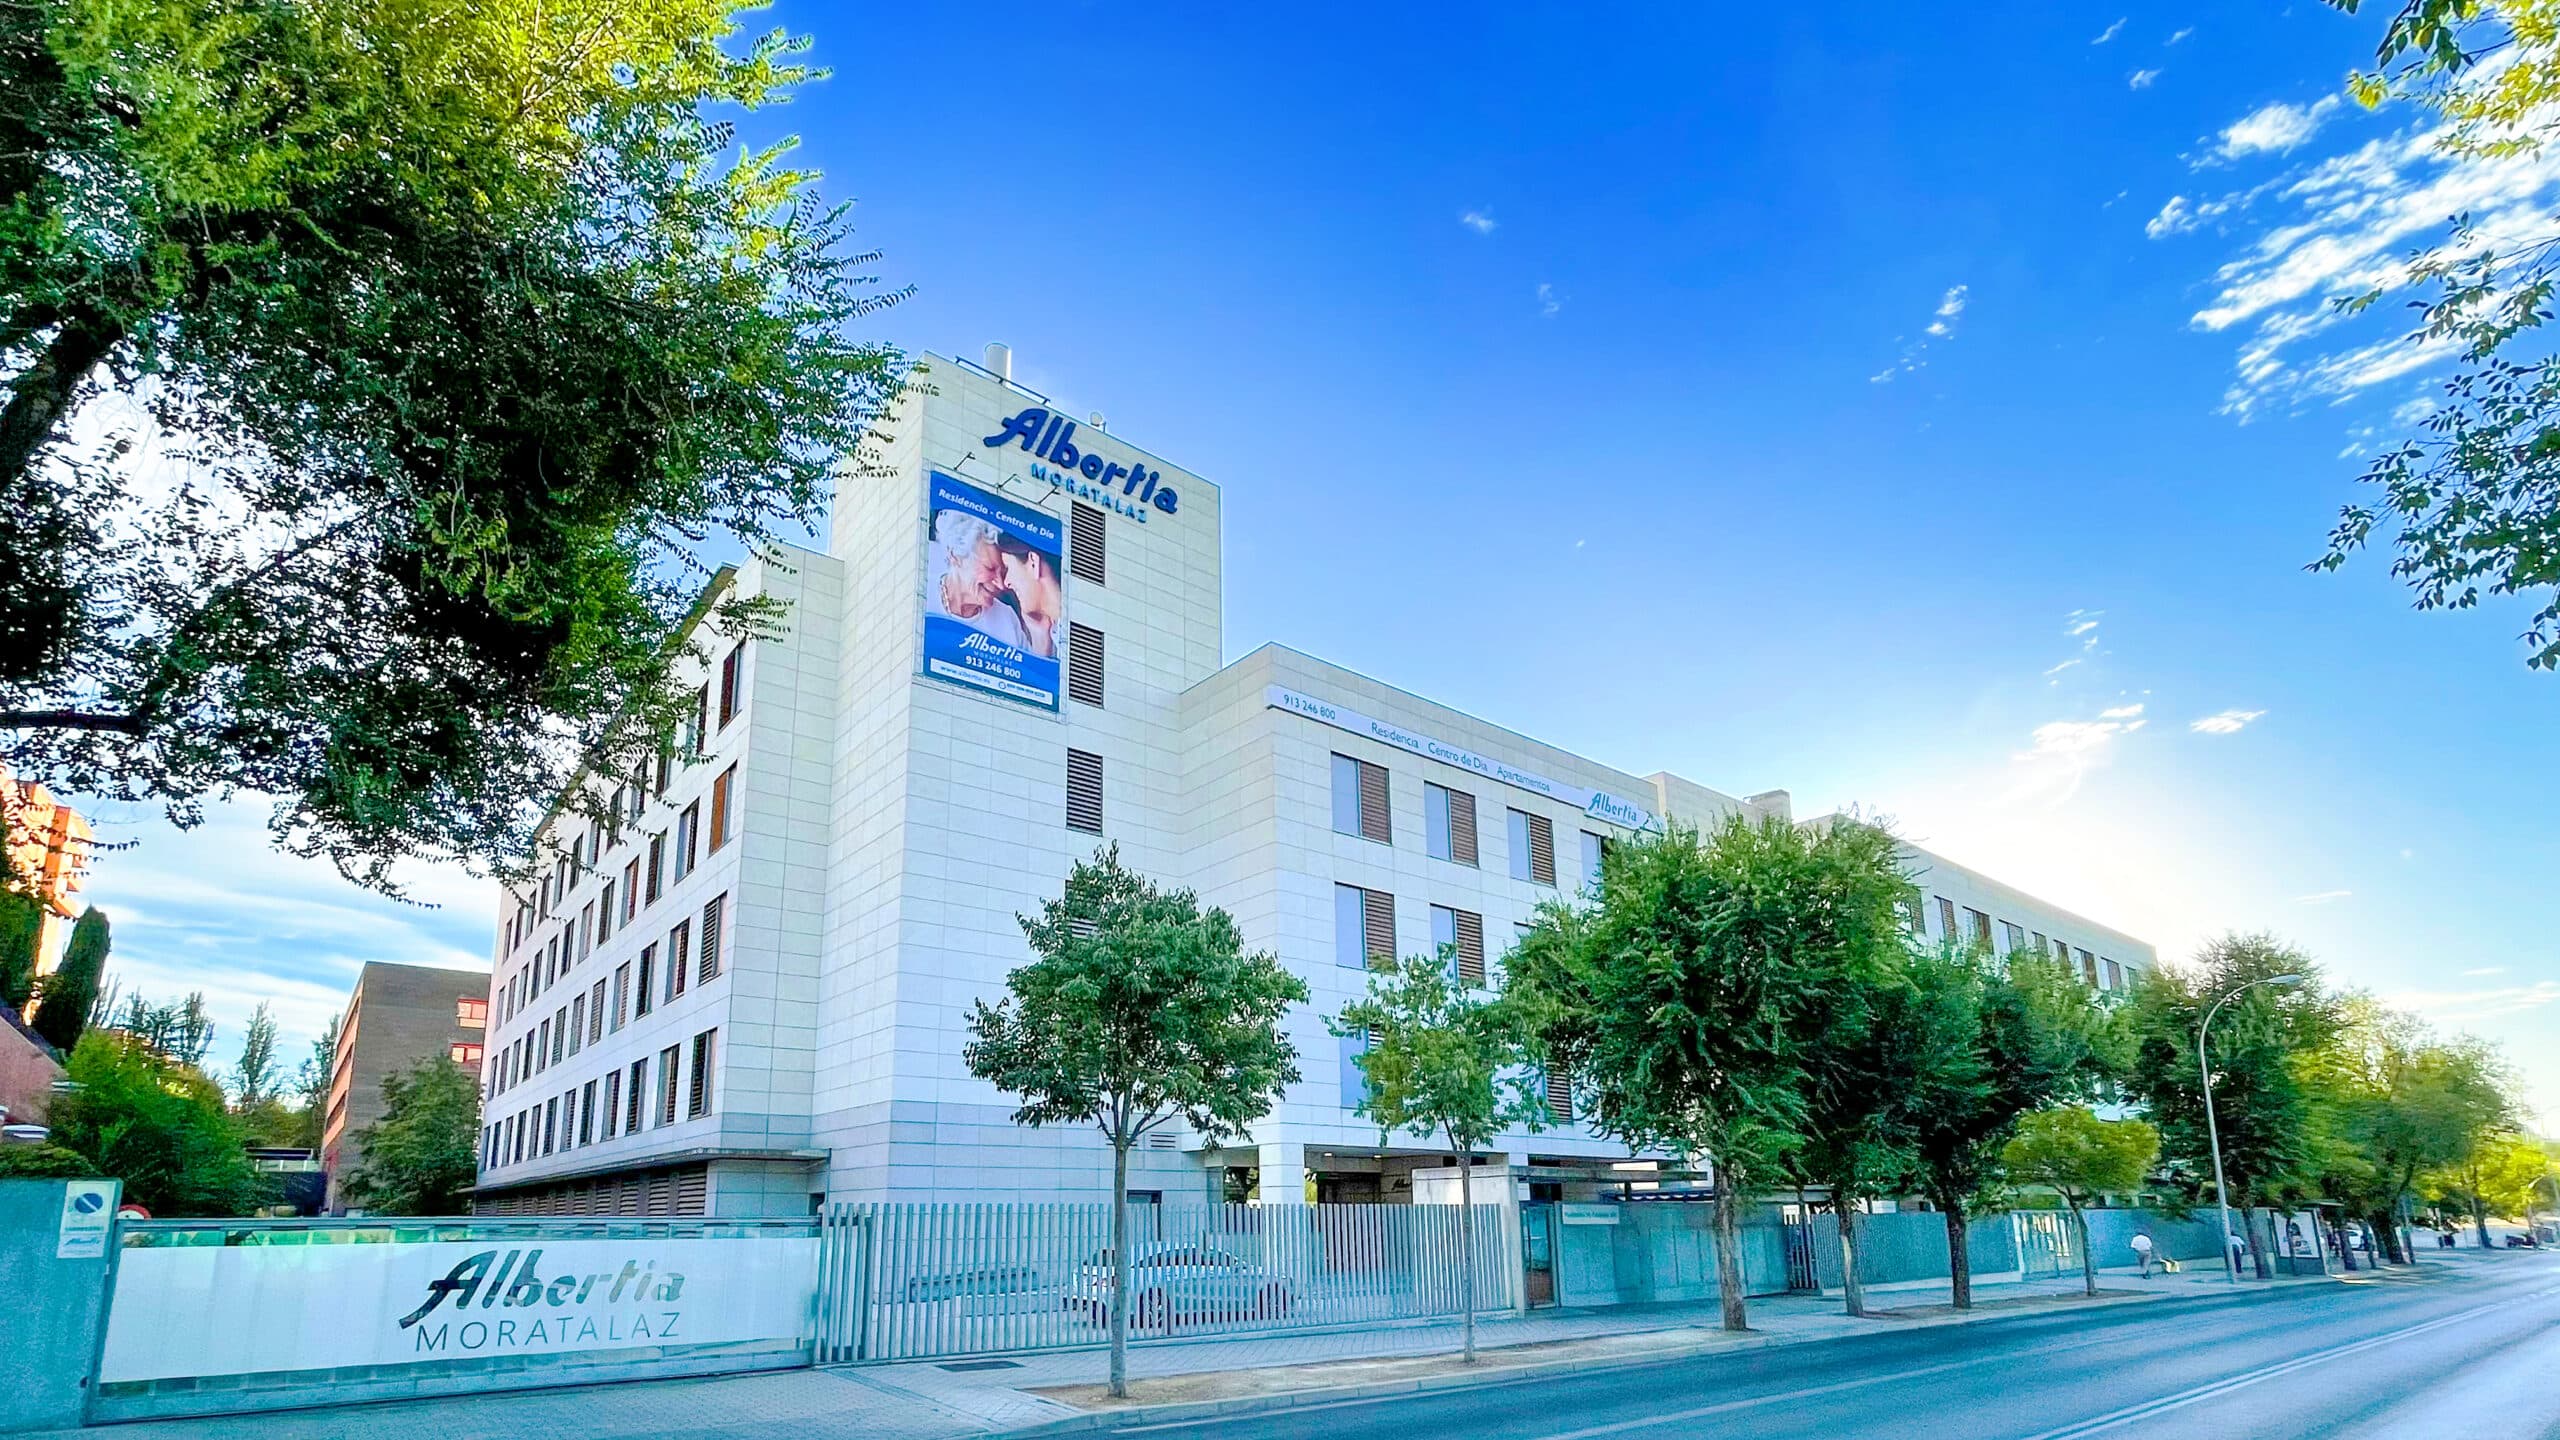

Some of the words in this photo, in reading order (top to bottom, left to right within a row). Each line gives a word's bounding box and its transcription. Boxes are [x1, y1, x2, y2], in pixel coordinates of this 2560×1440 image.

[983, 408, 1178, 514] Albertia
[939, 489, 989, 514] Residencia
[996, 511, 1025, 529] Centro
[1026, 523, 1038, 533] de
[1031, 462, 1147, 523] MORATALAZ
[959, 633, 1023, 662] Albertia
[965, 655, 983, 668] 913
[985, 662, 1002, 673] 246
[1003, 667, 1021, 679] 800
[1284, 694, 1300, 708] 913
[1302, 701, 1318, 714] 246
[1320, 706, 1336, 719] 800
[1371, 722, 1419, 748] Residencia
[1428, 742, 1459, 760] Centro
[1461, 753, 1472, 766] de
[1497, 766, 1551, 792] Apartamentos
[1588, 792, 1637, 822] Albertia
[399, 1250, 686, 1330] Albertia
[416, 1312, 681, 1352] MORATALAZ
